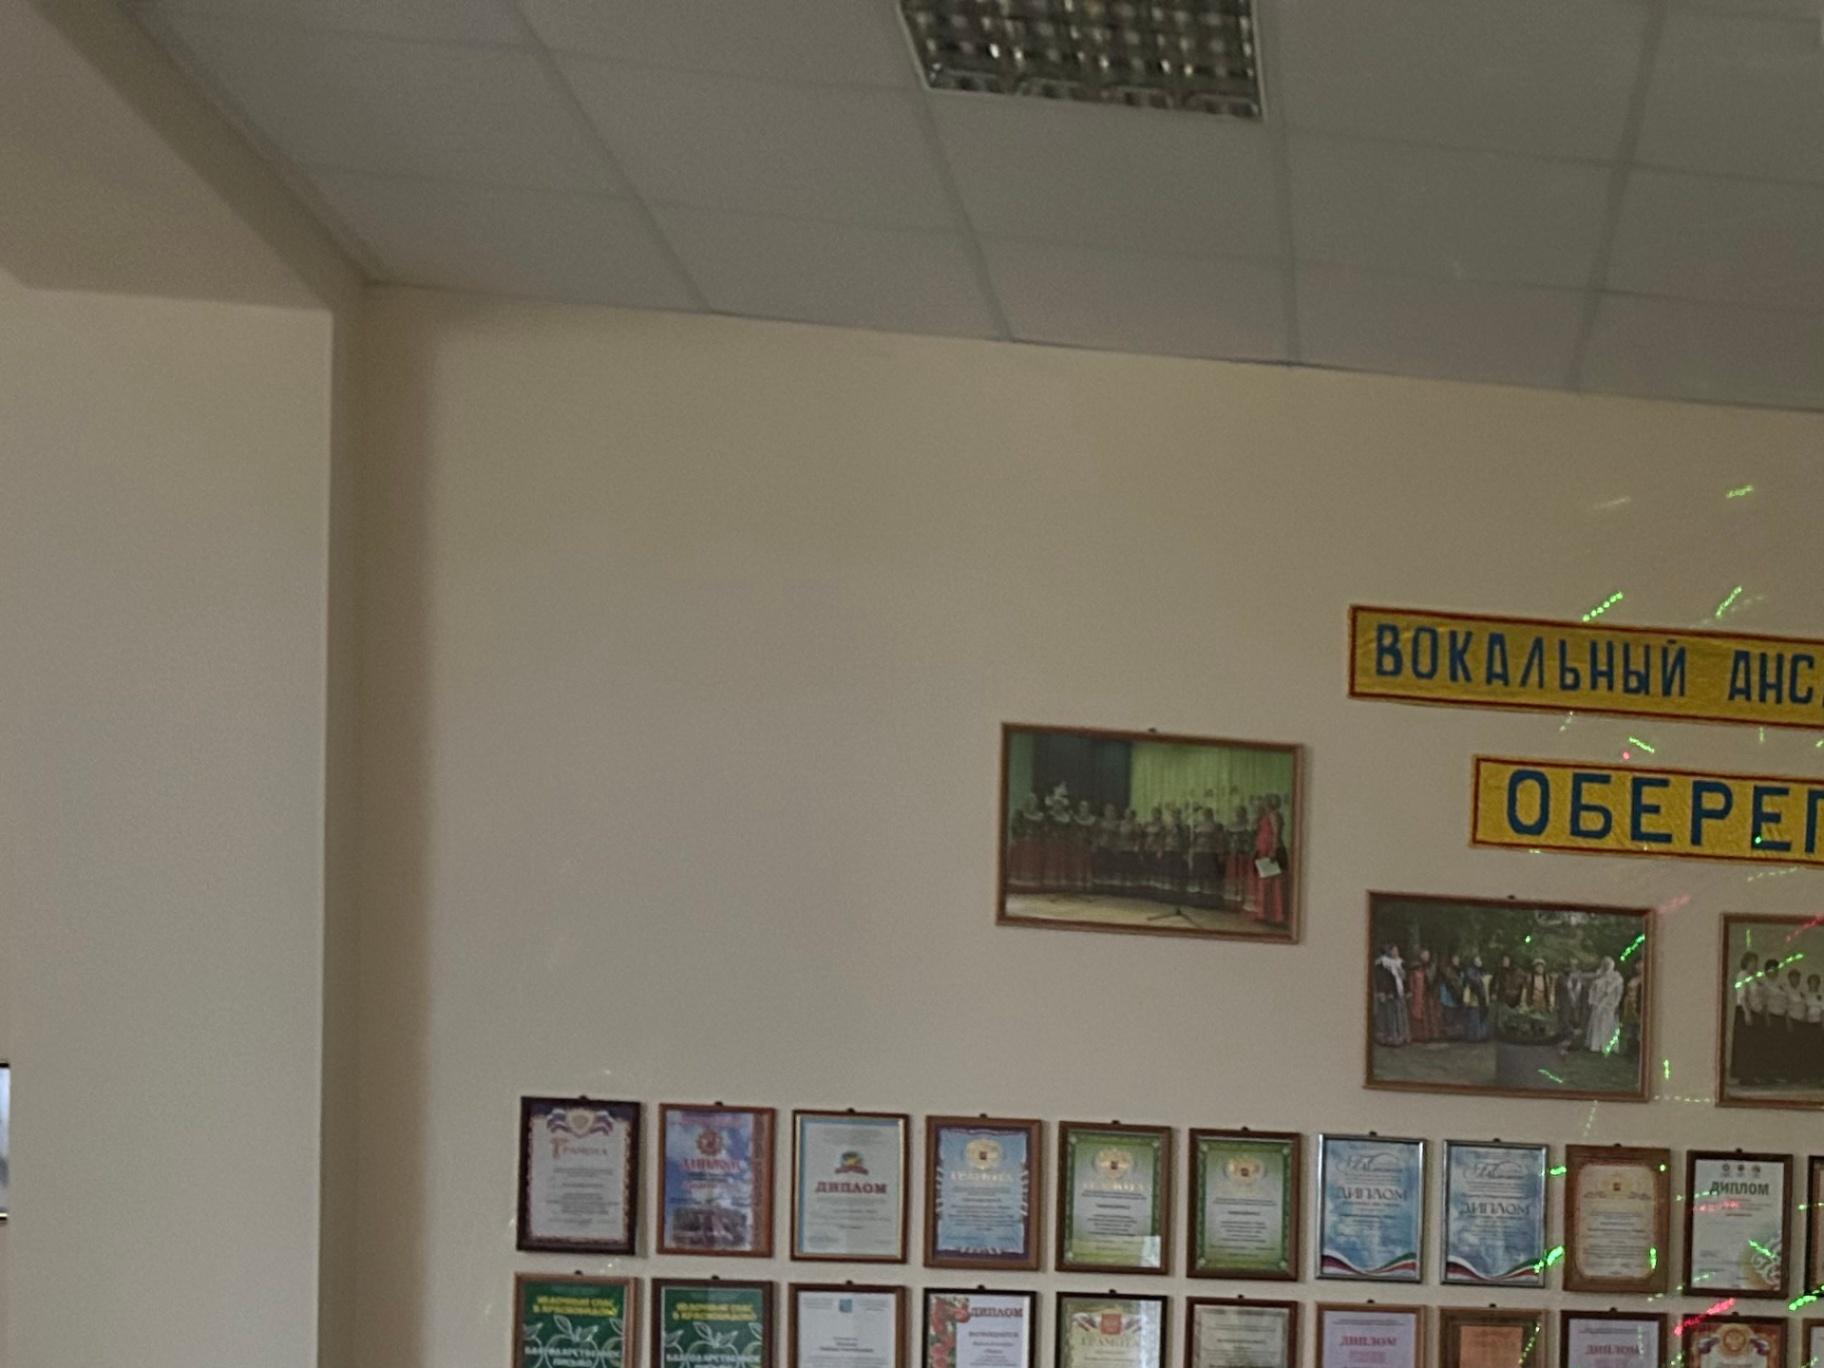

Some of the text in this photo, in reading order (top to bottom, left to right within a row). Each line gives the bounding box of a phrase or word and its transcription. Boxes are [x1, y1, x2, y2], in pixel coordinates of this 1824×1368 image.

[1374, 621, 1687, 698] ВОКАЛЬНЫЙ
[814, 1180, 889, 1195] ДИПЛОМ
[1336, 1187, 1408, 1202] ДИПЛОМ
[1709, 1181, 1770, 1196] ДИПЛОМ
[1459, 1200, 1531, 1216] ДИПЛОМ
[970, 1307, 1024, 1319] ДИПЛОМ
[1339, 1335, 1398, 1347] ДИПЛОМ
